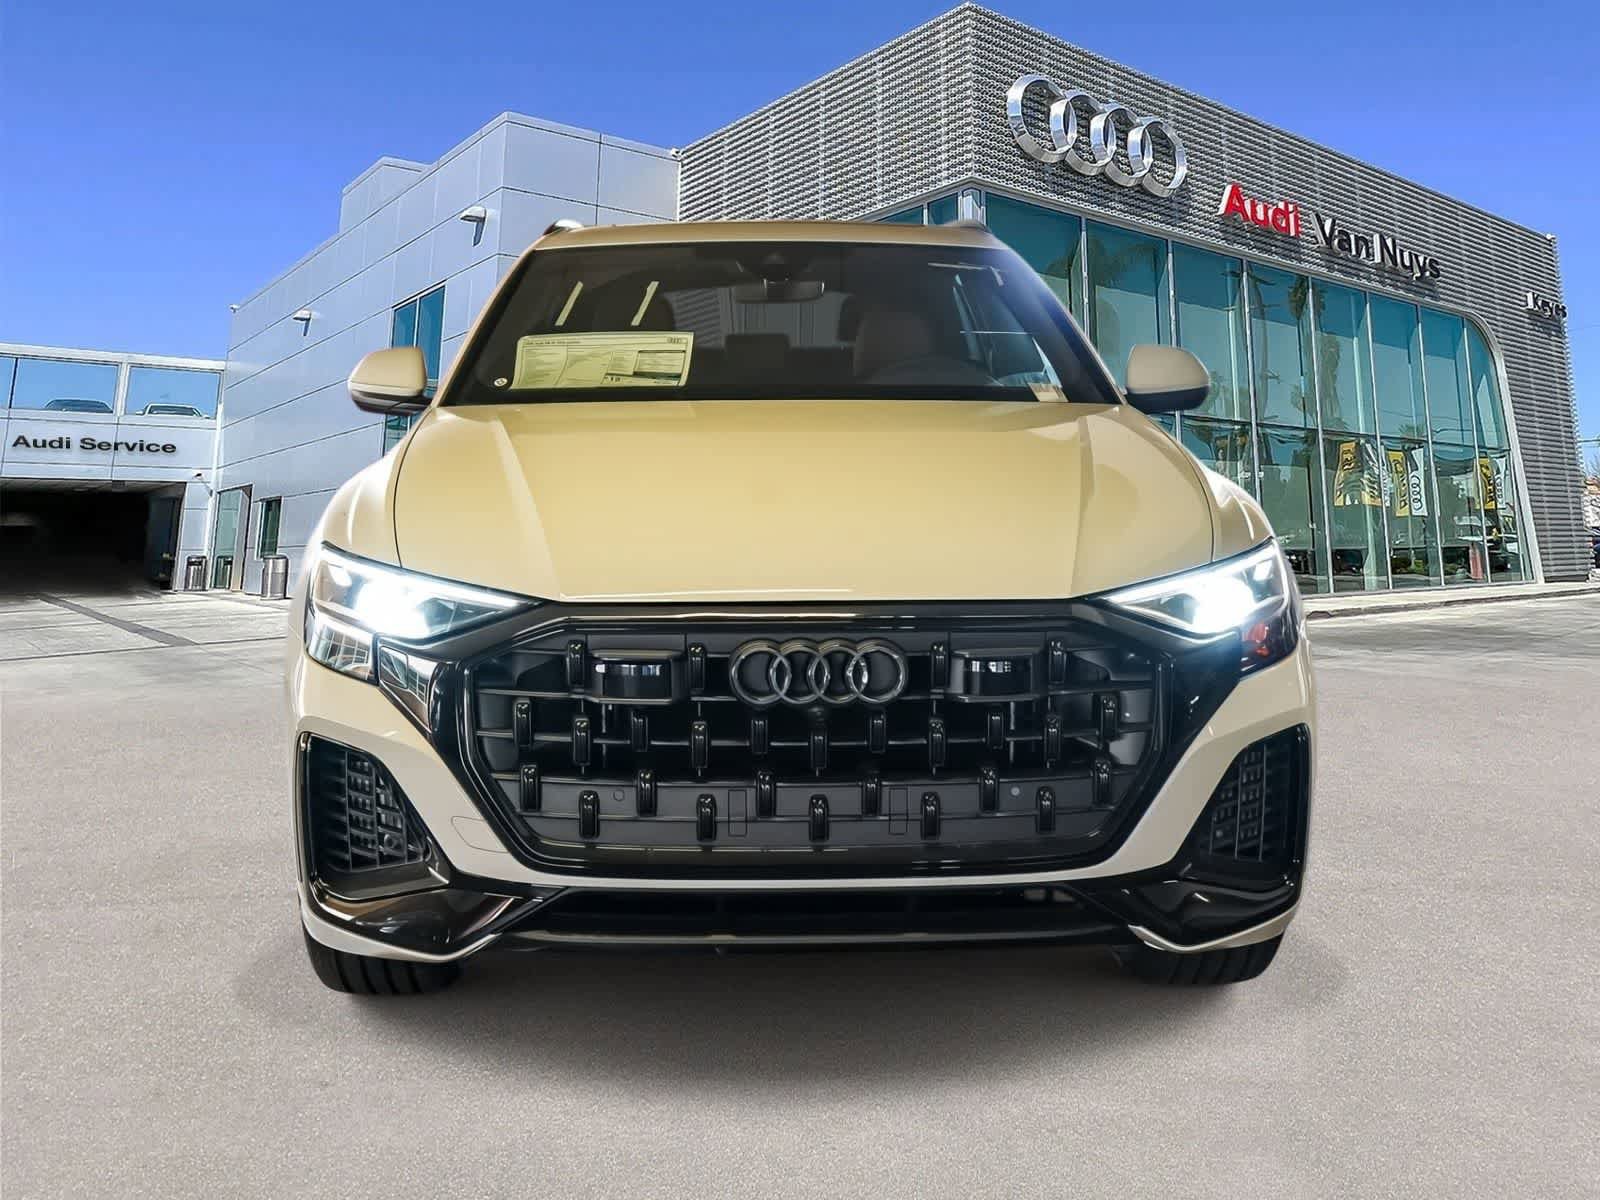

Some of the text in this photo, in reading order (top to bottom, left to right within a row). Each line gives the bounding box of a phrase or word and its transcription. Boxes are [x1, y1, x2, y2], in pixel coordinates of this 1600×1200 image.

[1219, 182, 1442, 280] Audi Van Nuys
[13, 435, 177, 454] Audi Service
